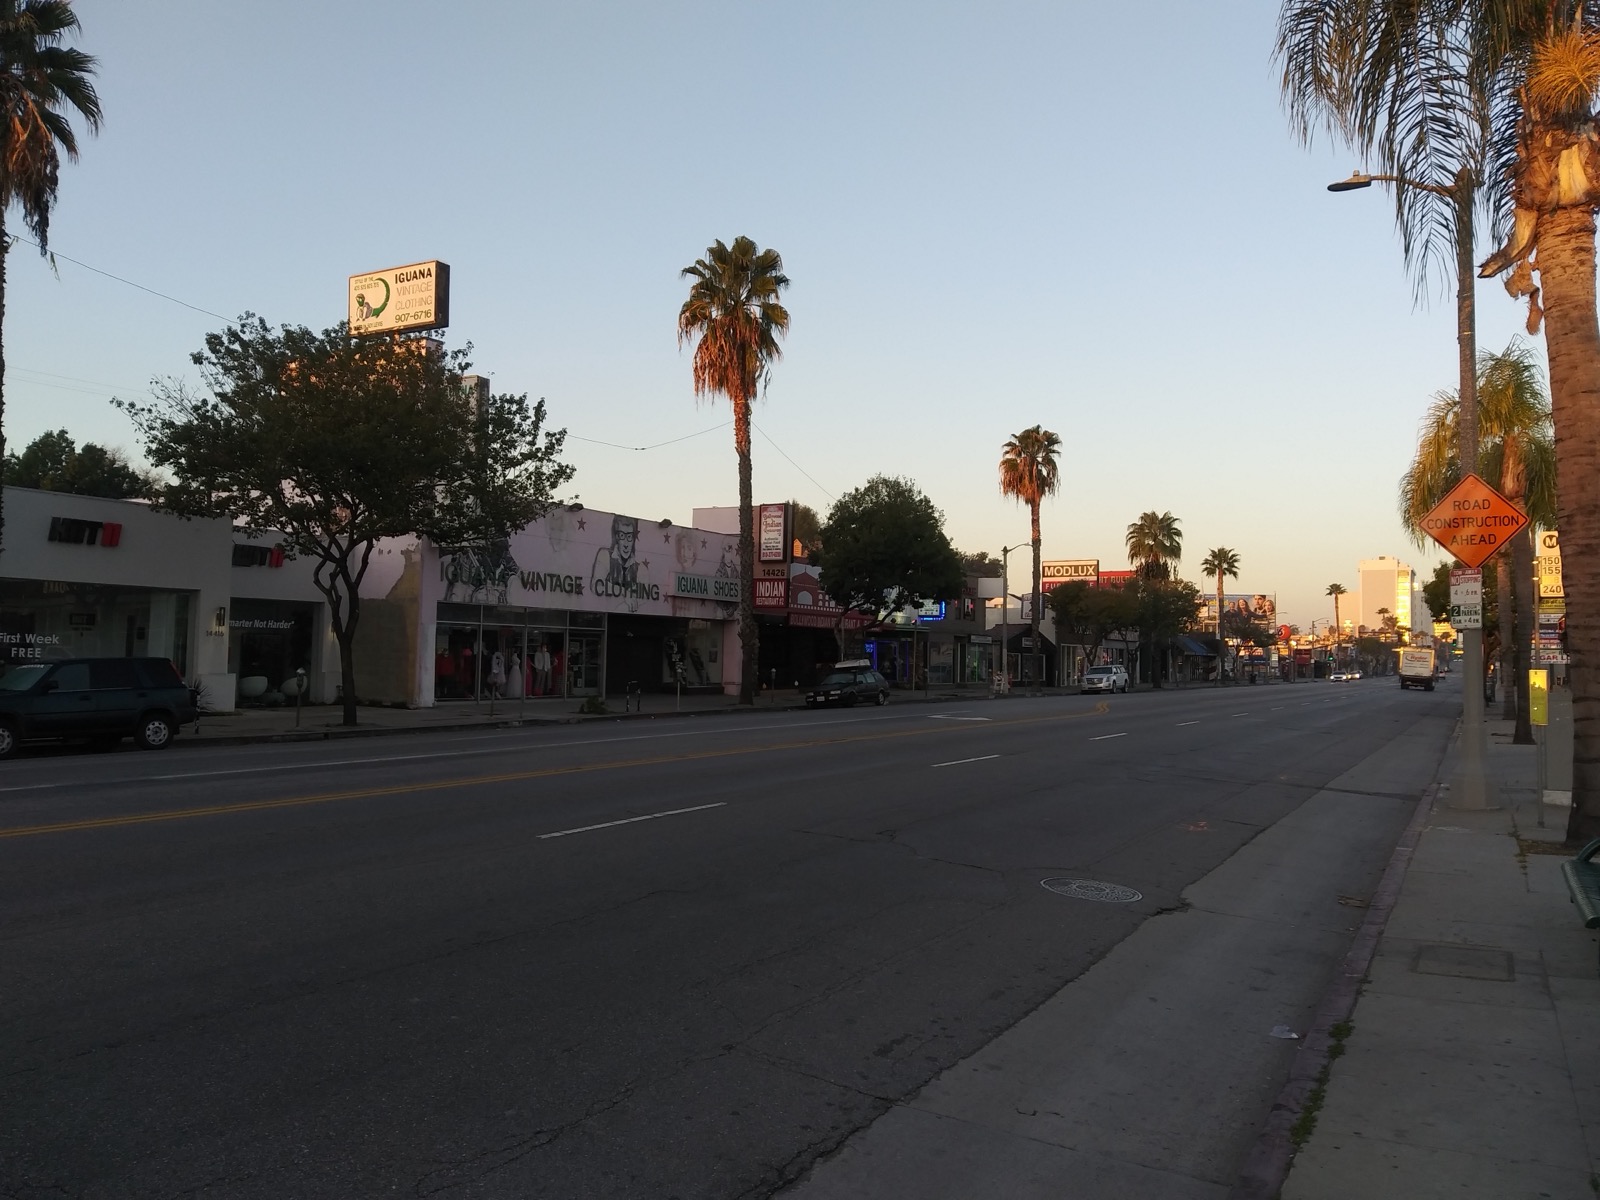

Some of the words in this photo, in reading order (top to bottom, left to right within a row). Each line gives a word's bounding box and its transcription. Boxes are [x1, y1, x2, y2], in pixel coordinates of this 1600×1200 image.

[395, 267, 432, 284] IGUANA
[396, 281, 432, 296] VINTAGE
[395, 296, 432, 310] CLOTHING
[395, 309, 432, 323] 907-6716
[1453, 499, 1491, 511] ROAD
[1427, 515, 1520, 529] CONSTRUCTION
[1450, 533, 1497, 546] AHEAD
[1543, 556, 1560, 565] 150
[762, 568, 785, 577] 14426
[1044, 565, 1096, 577] MODLUX
[1543, 566, 1561, 575] 155
[520, 571, 583, 595] VINTAGE
[594, 579, 660, 601] CLOTHING
[677, 576, 708, 595] IGUANA
[713, 580, 739, 597] SHOES
[1451, 576, 1460, 586] NO
[1460, 576, 1481, 584] STOPPING
[756, 581, 785, 597] INDIAN
[1543, 585, 1562, 594] 240
[756, 597, 780, 606] RESTAURANT
[1453, 606, 1459, 616] 2
[1461, 608, 1481, 617] PARKING
[253, 619, 266, 628] Not
[0, 632, 21, 643] First
[25, 633, 60, 645] Week
[11, 647, 42, 658] FREE
